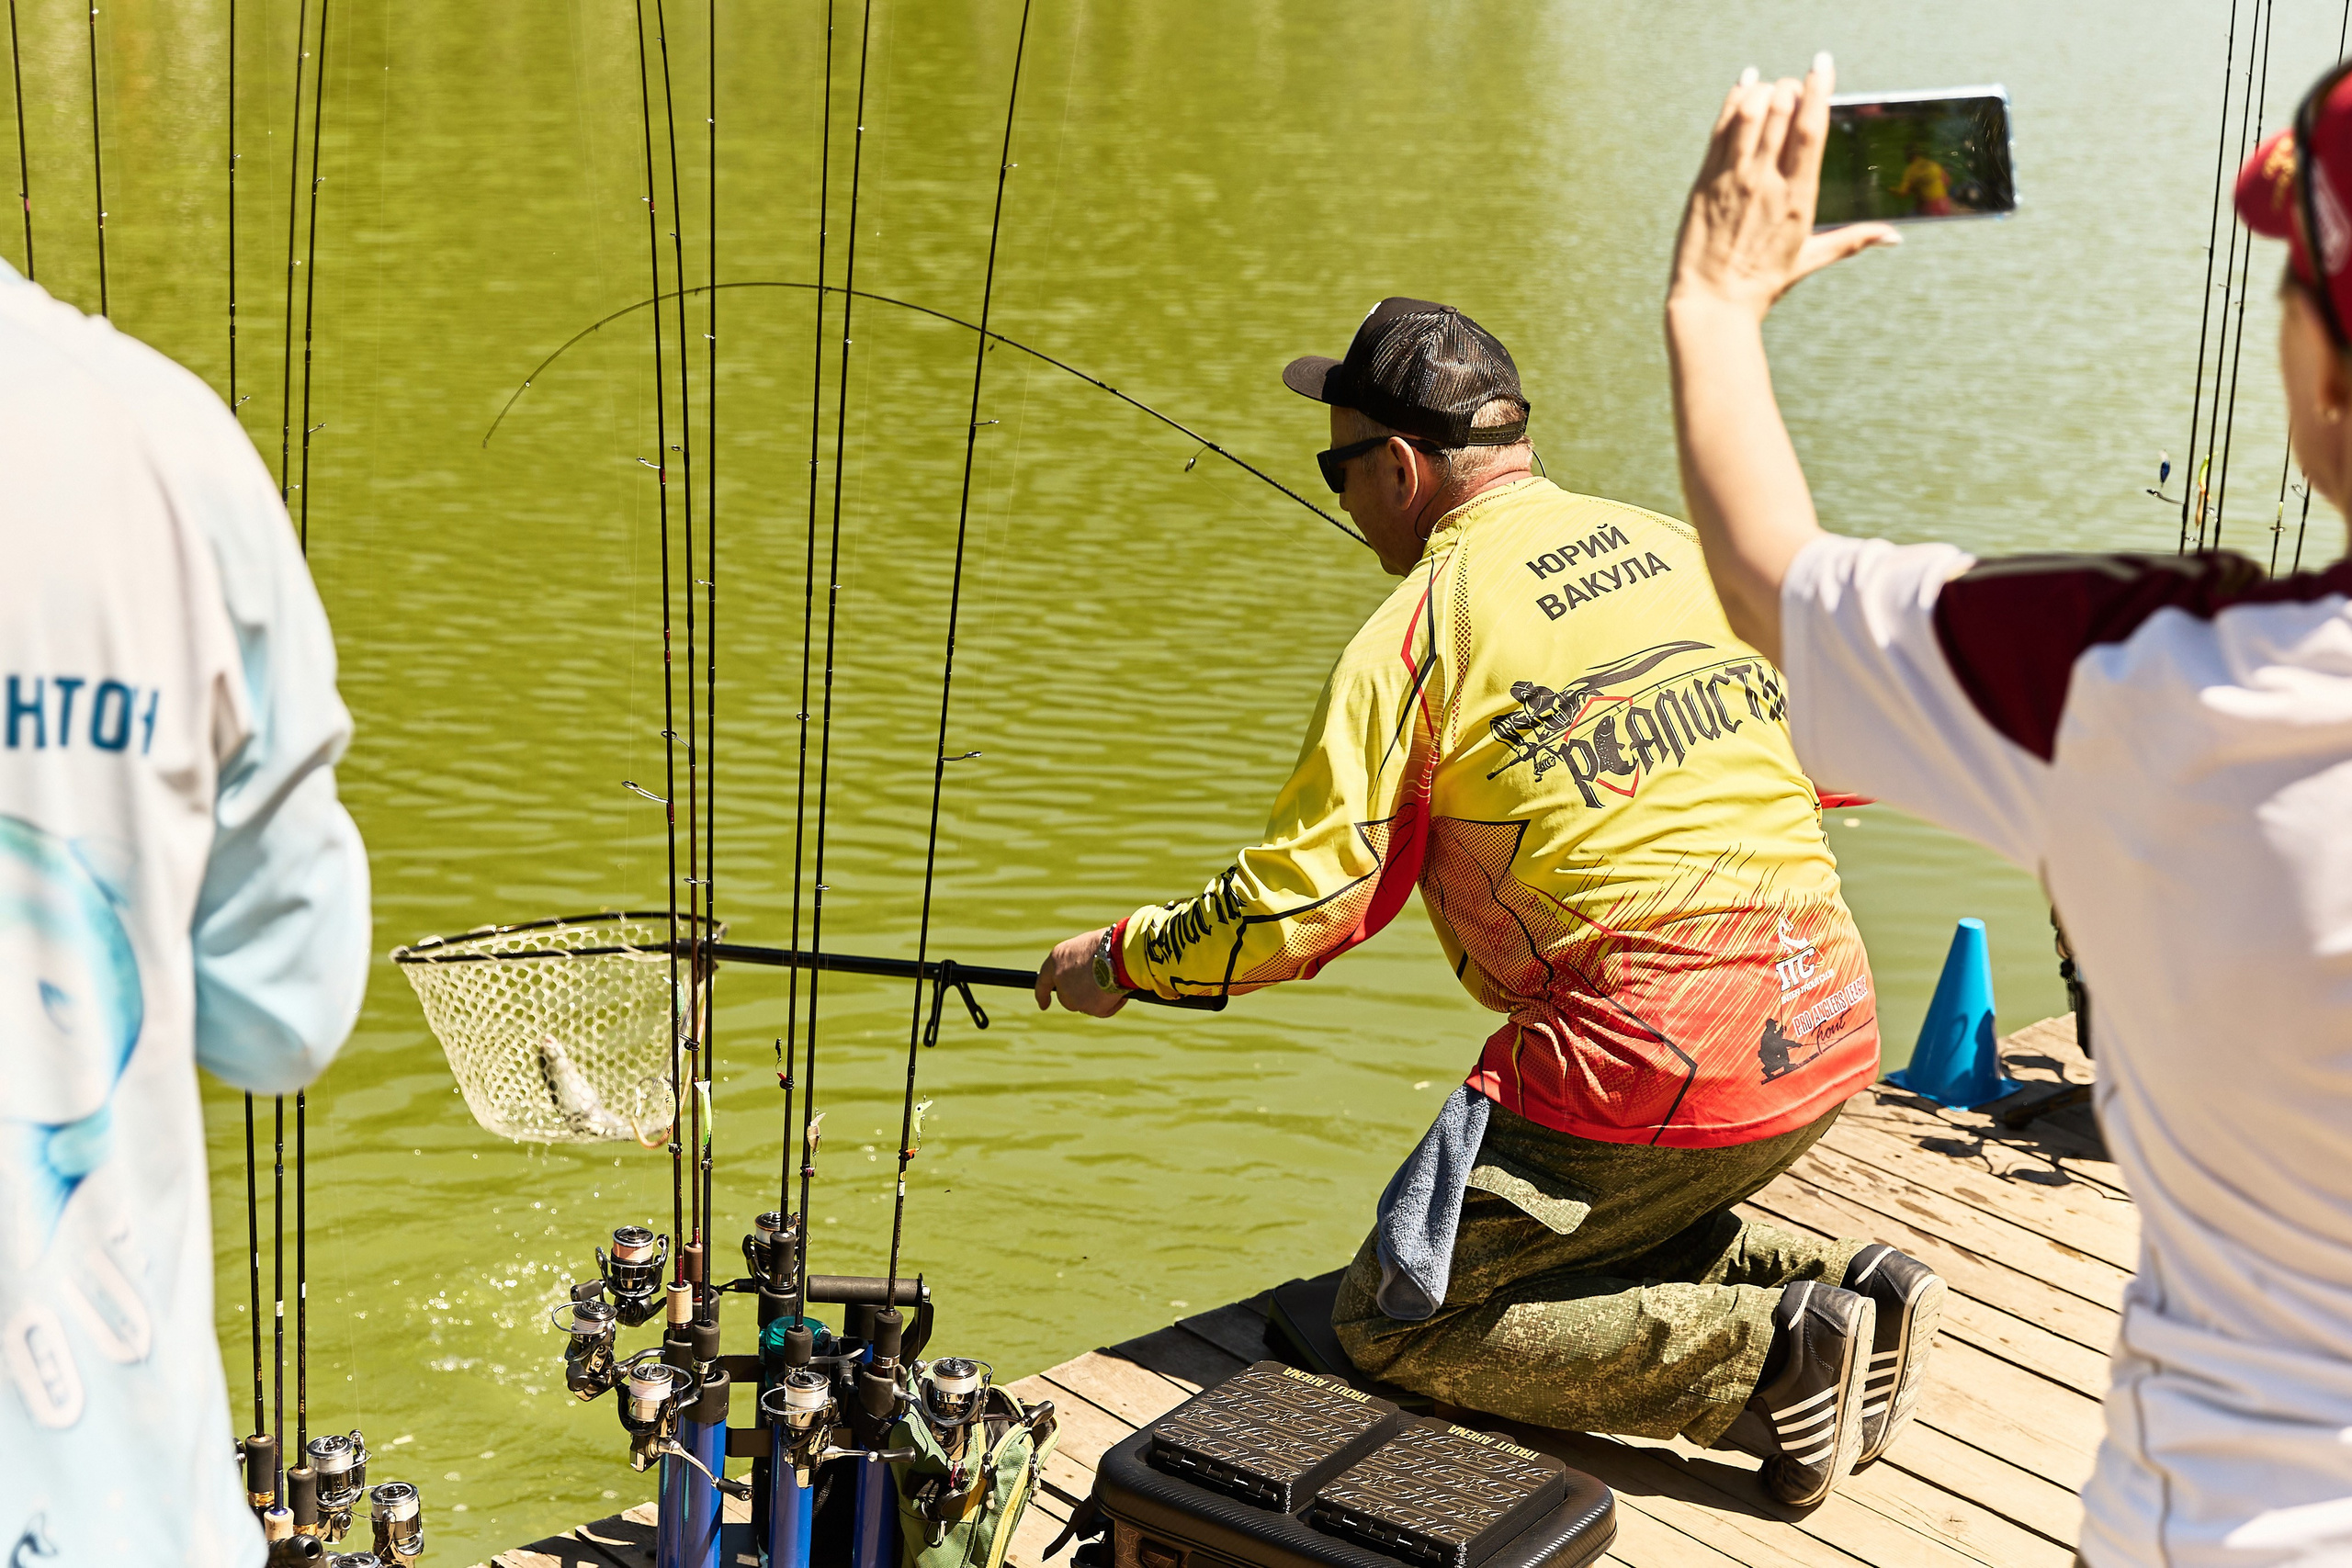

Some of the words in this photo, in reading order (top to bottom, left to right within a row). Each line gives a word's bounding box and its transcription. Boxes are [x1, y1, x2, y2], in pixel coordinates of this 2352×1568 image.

[1525, 523, 1630, 581] ЮРИЙ
[1535, 551, 1672, 621] ВАКУЛА
[1775, 946, 1816, 992] ITC
[1792, 1010, 1814, 1037] PRO
[1812, 990, 1848, 1026] ANGLERS
[1282, 1367, 1330, 1388] ARENA
[1326, 1383, 1373, 1404] TROUT
[1447, 1424, 1497, 1446] ARENA
[1492, 1440, 1541, 1461] TROUT
